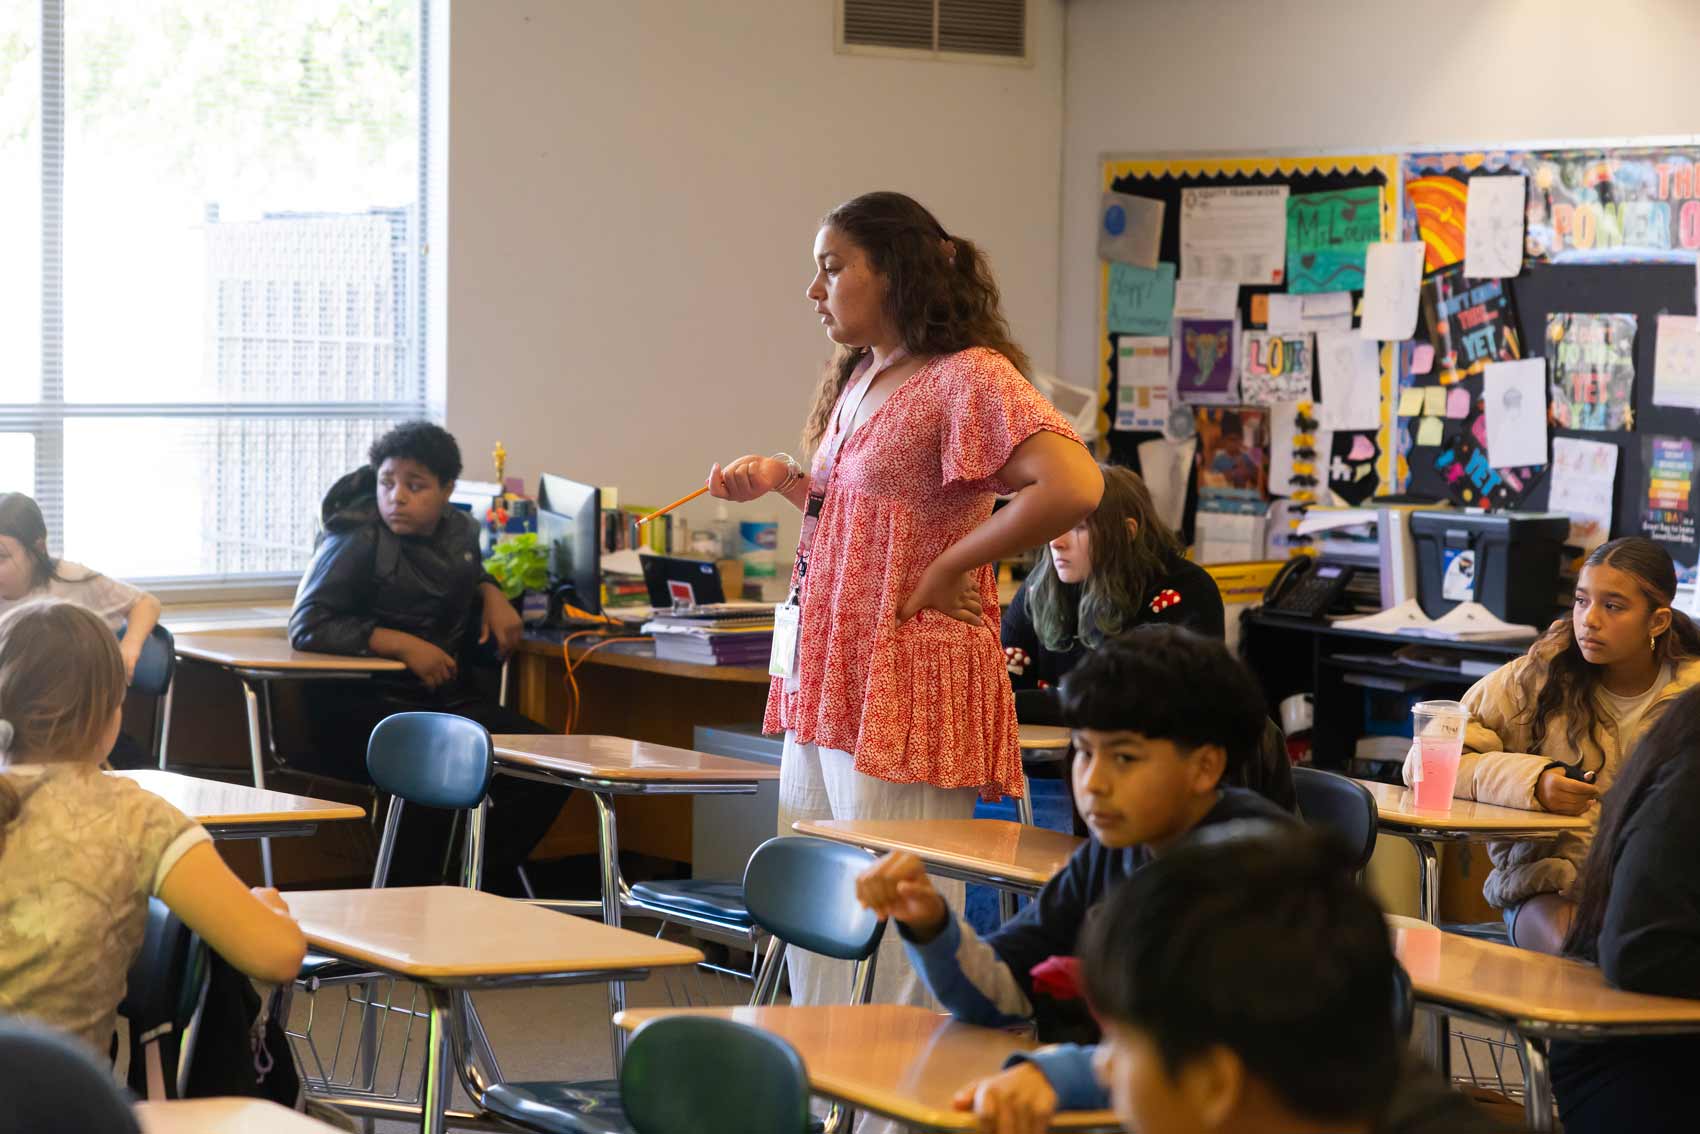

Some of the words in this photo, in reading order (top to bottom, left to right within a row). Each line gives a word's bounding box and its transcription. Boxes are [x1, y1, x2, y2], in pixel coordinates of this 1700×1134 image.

[1551, 200, 1671, 251] POWER
[1250, 337, 1304, 377] LOVE
[1462, 325, 1497, 361] YET
[1465, 448, 1502, 496] YET
